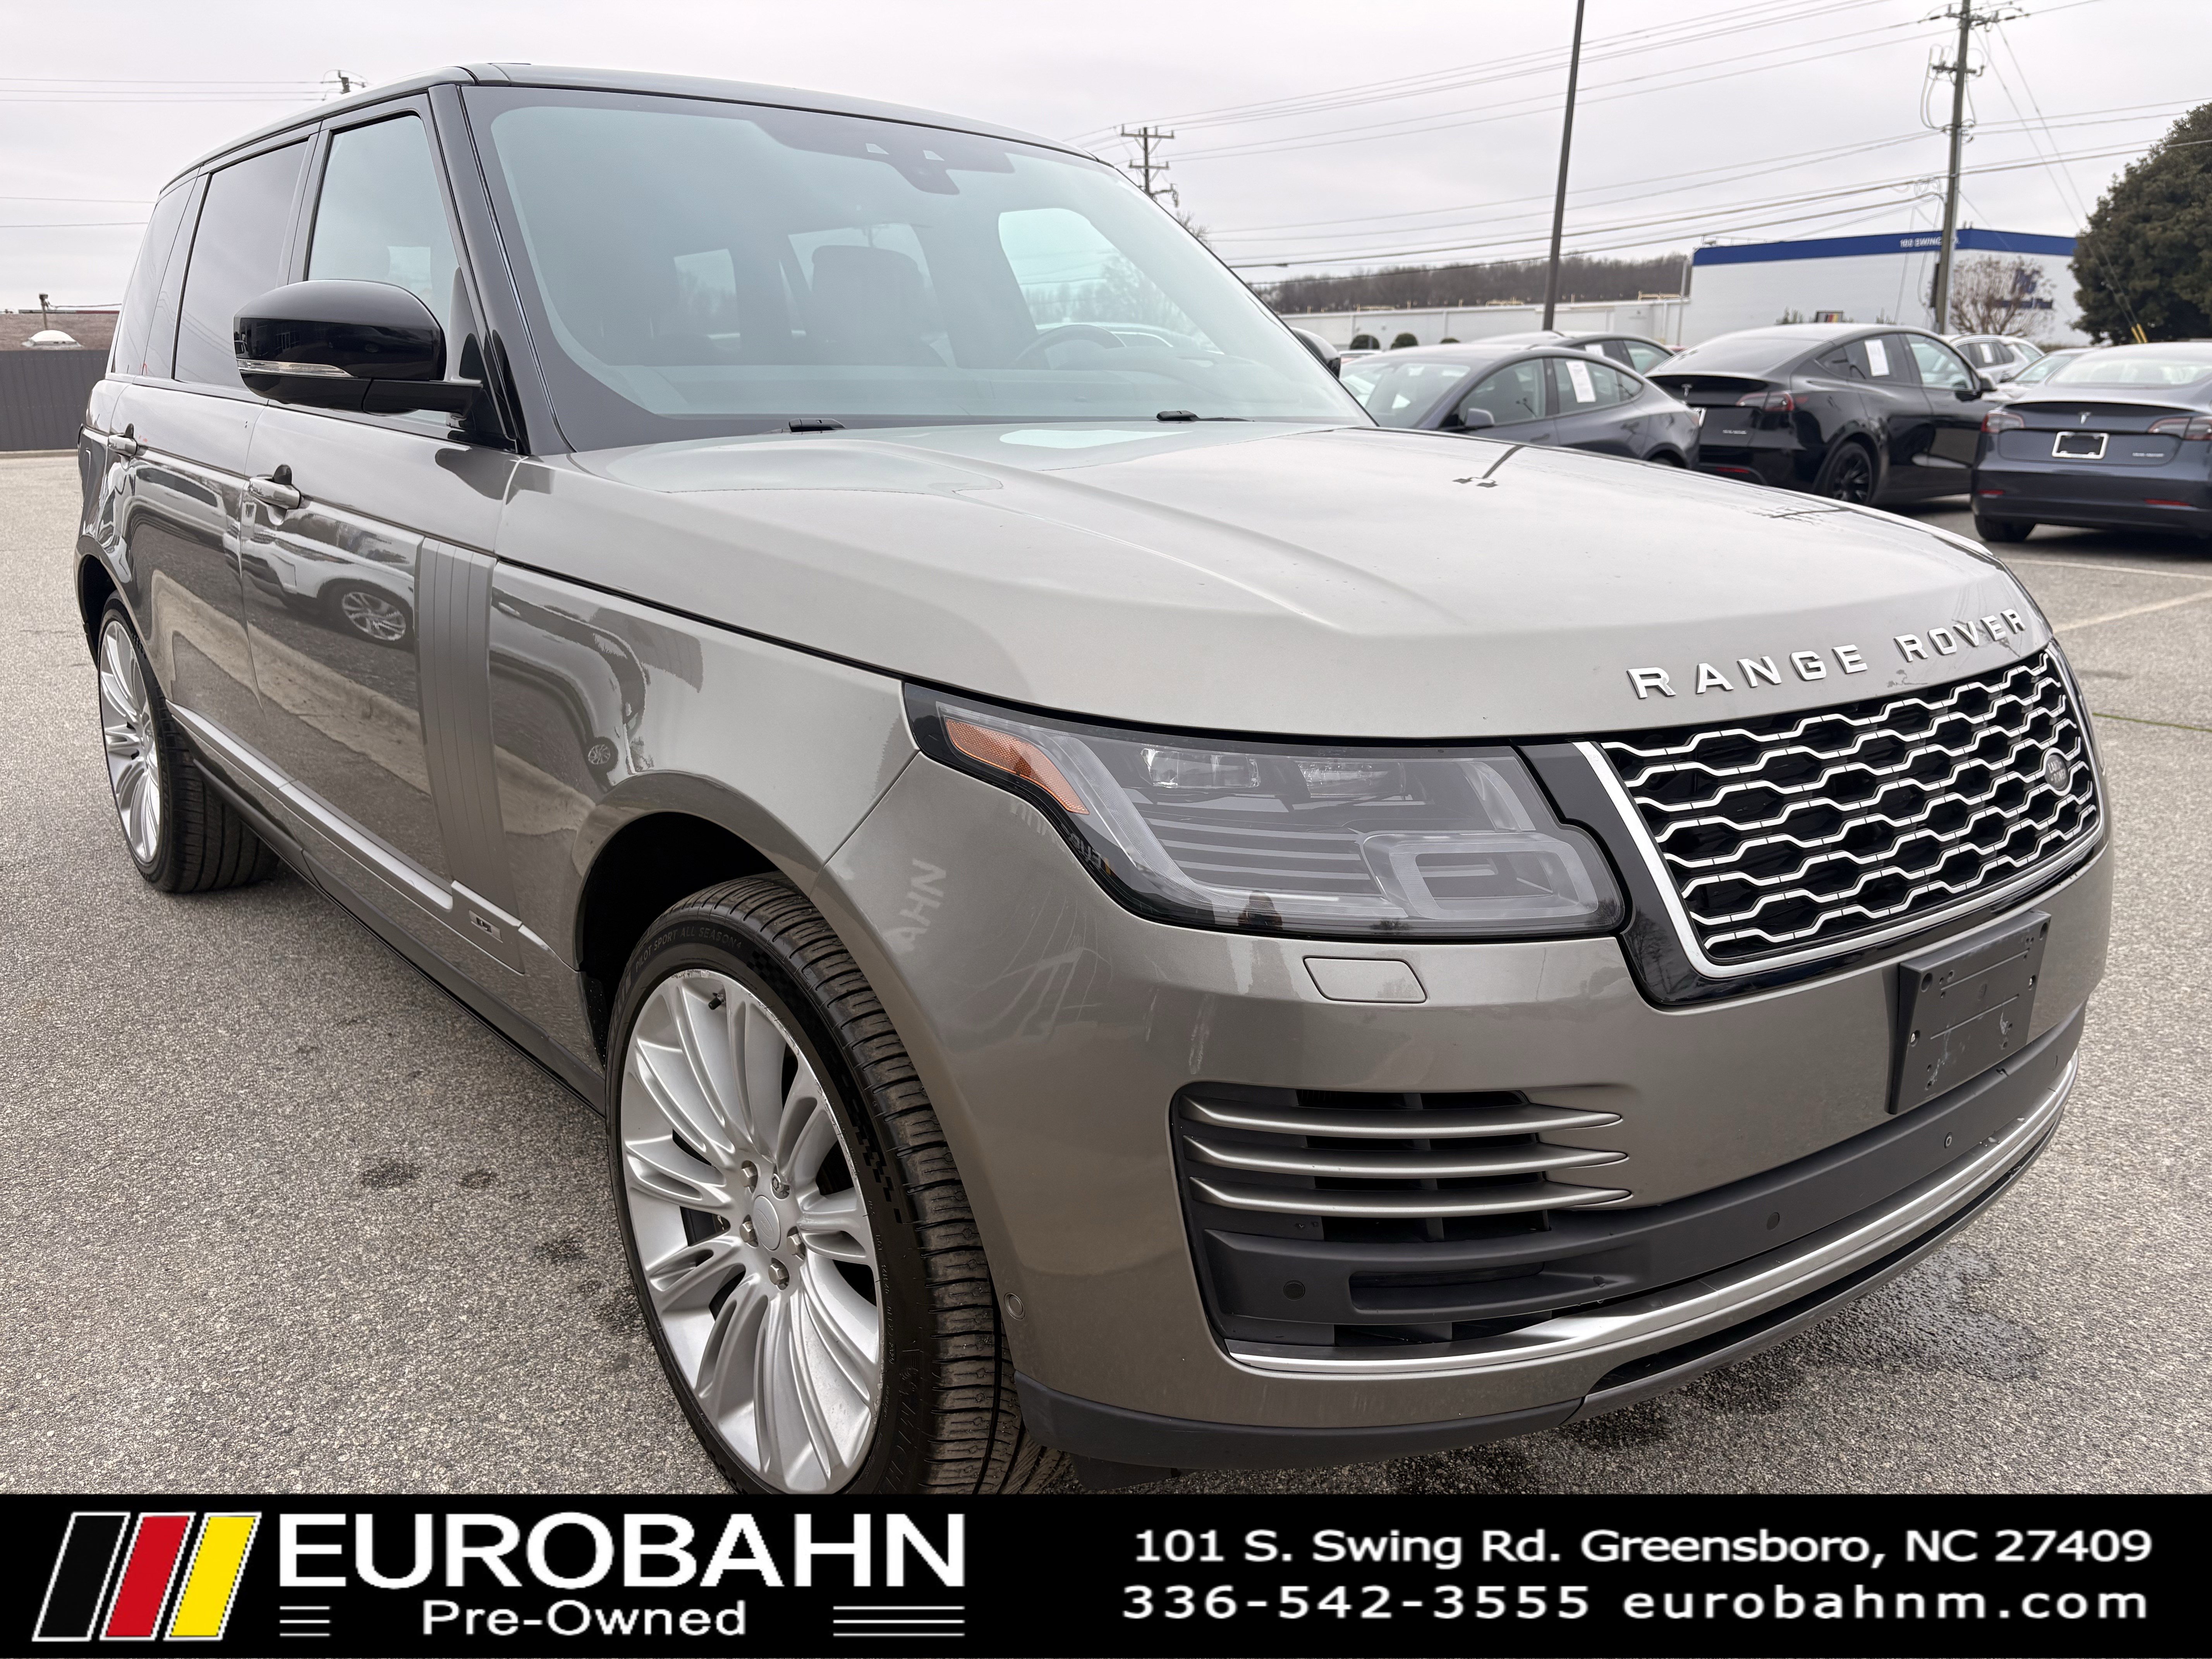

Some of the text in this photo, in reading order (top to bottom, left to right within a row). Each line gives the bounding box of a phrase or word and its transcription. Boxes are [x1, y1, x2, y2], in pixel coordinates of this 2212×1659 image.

[1626, 608, 2026, 698] RANGE ROVER
[635, 945, 652, 973] PILOT
[654, 929, 677, 951] SPORT
[680, 926, 695, 938] ALL
[698, 927, 737, 948] SEASON
